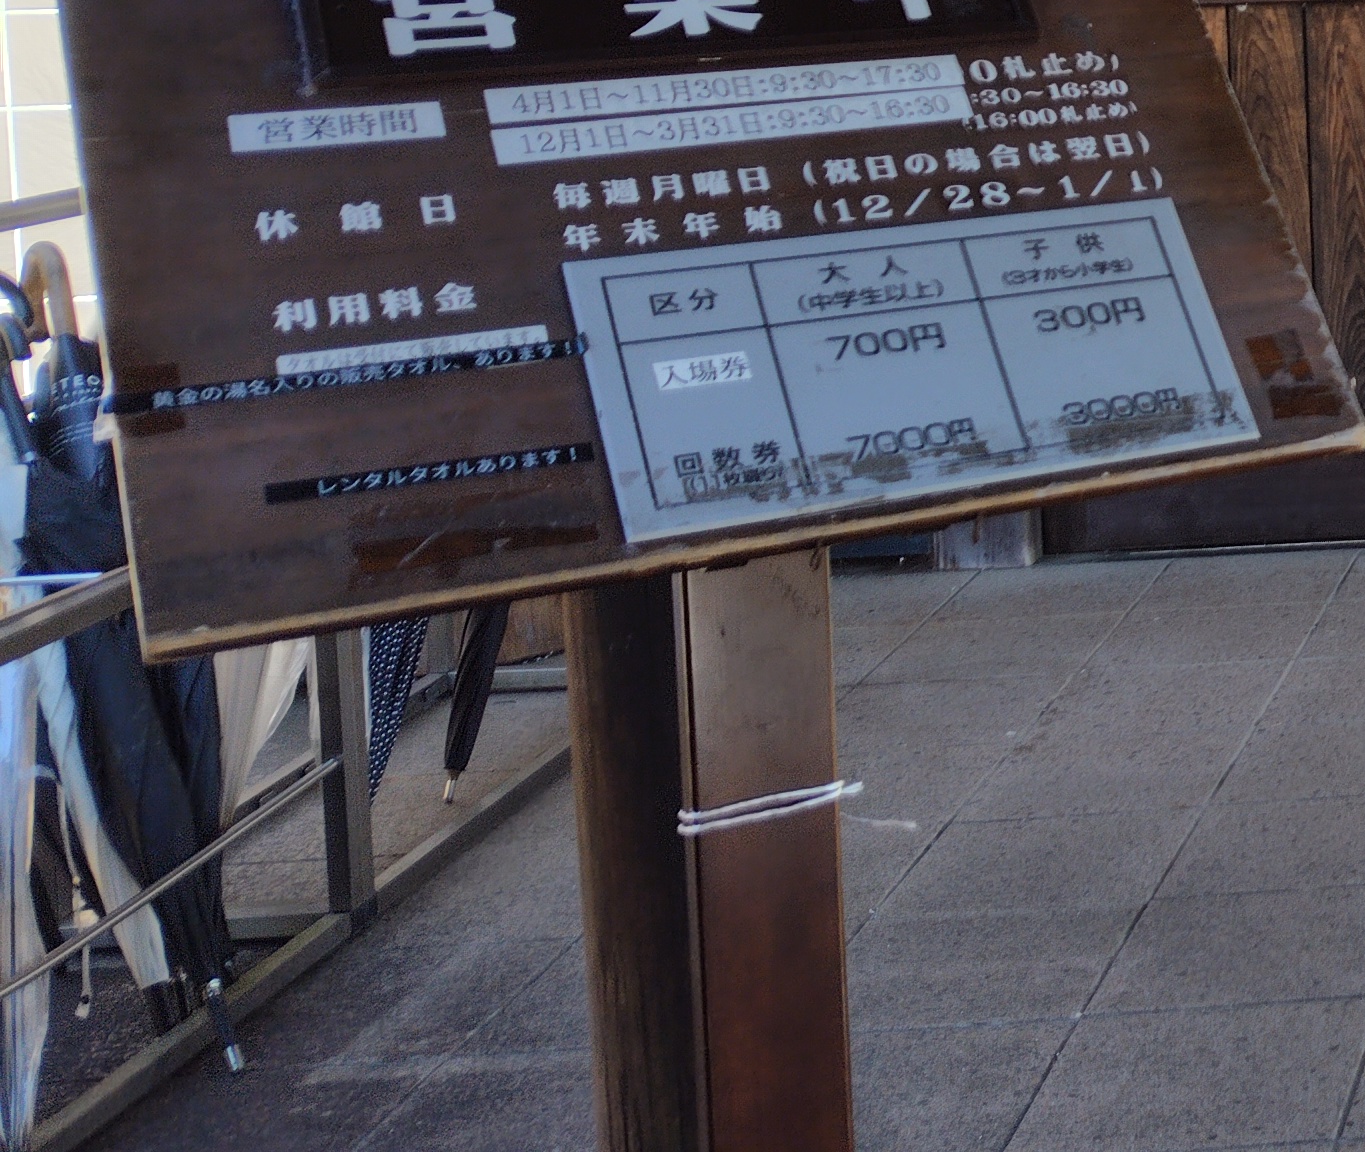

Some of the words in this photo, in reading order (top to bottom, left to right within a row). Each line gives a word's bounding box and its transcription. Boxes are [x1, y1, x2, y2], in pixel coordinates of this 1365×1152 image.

[257, 108, 418, 146] 営業時間
[552, 166, 772, 210] 毎週月曜日
[254, 193, 457, 242] 休館日
[562, 204, 784, 252] 年末年始
[1023, 232, 1105, 260] 子供
[817, 255, 908, 284] 大人
[273, 281, 478, 332] 利用料金
[650, 286, 720, 316] 区分
[1034, 297, 1147, 333] 300円
[825, 322, 947, 362] 700円
[659, 356, 750, 390] 入場券
[1062, 387, 1182, 426] 3000円
[673, 439, 782, 479] 回数券
[846, 417, 977, 464] 7000円
